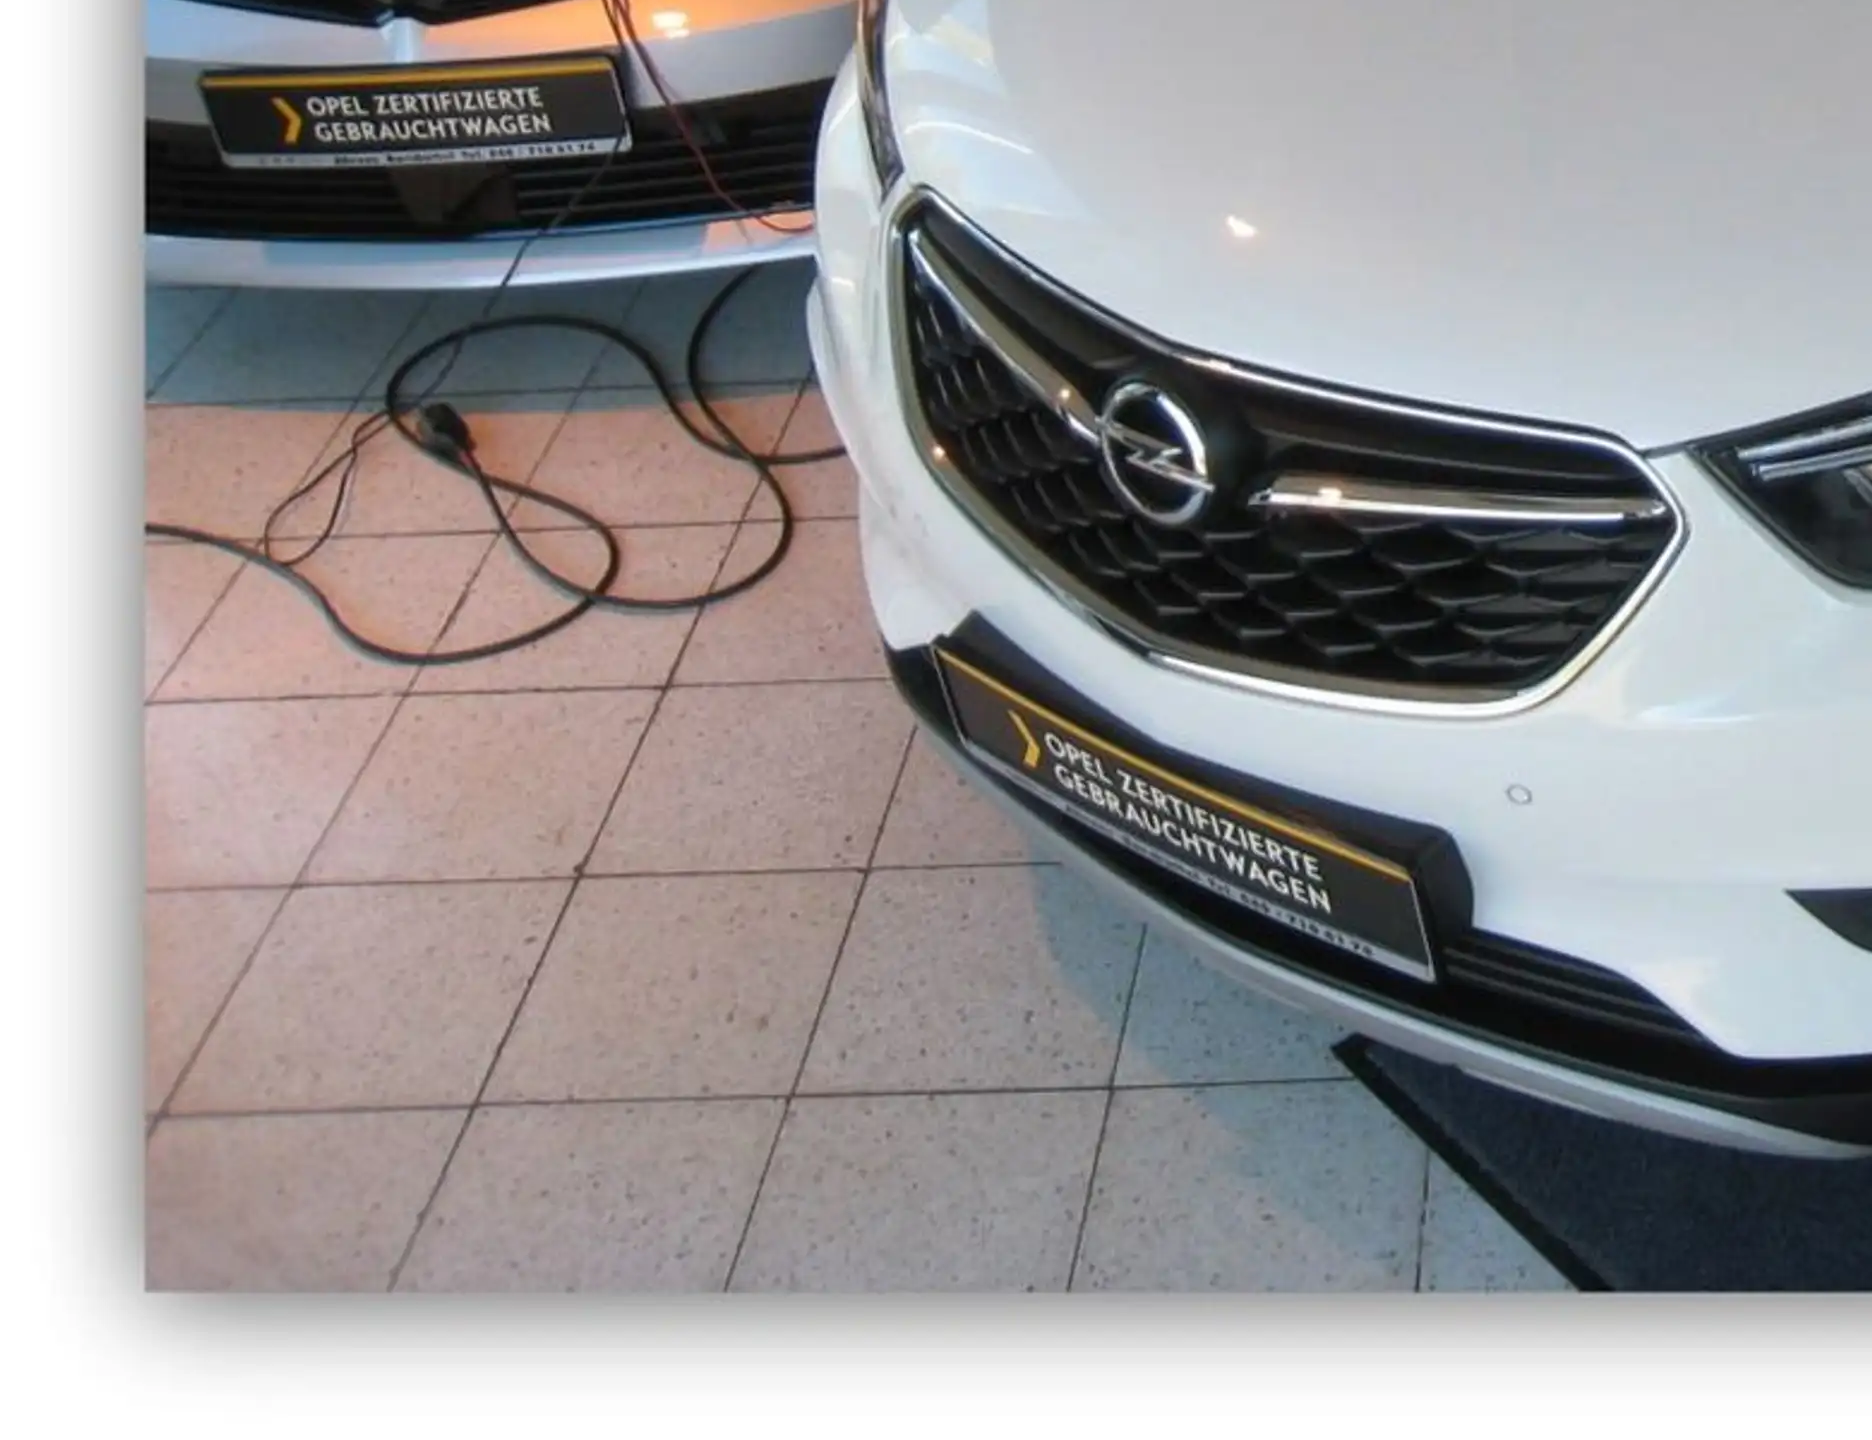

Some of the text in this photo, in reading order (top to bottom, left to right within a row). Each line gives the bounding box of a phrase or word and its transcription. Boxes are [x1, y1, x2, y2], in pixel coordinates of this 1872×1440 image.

[306, 86, 544, 117] OPEL ZERTIFIZIERTE
[314, 114, 552, 142] GEBRAUCHTWAGEN
[1044, 731, 1112, 785] OPEL
[1116, 769, 1323, 881] ZERTIFIZIERTE
[1054, 764, 1331, 914] GEBRAUCHTWAGEN
